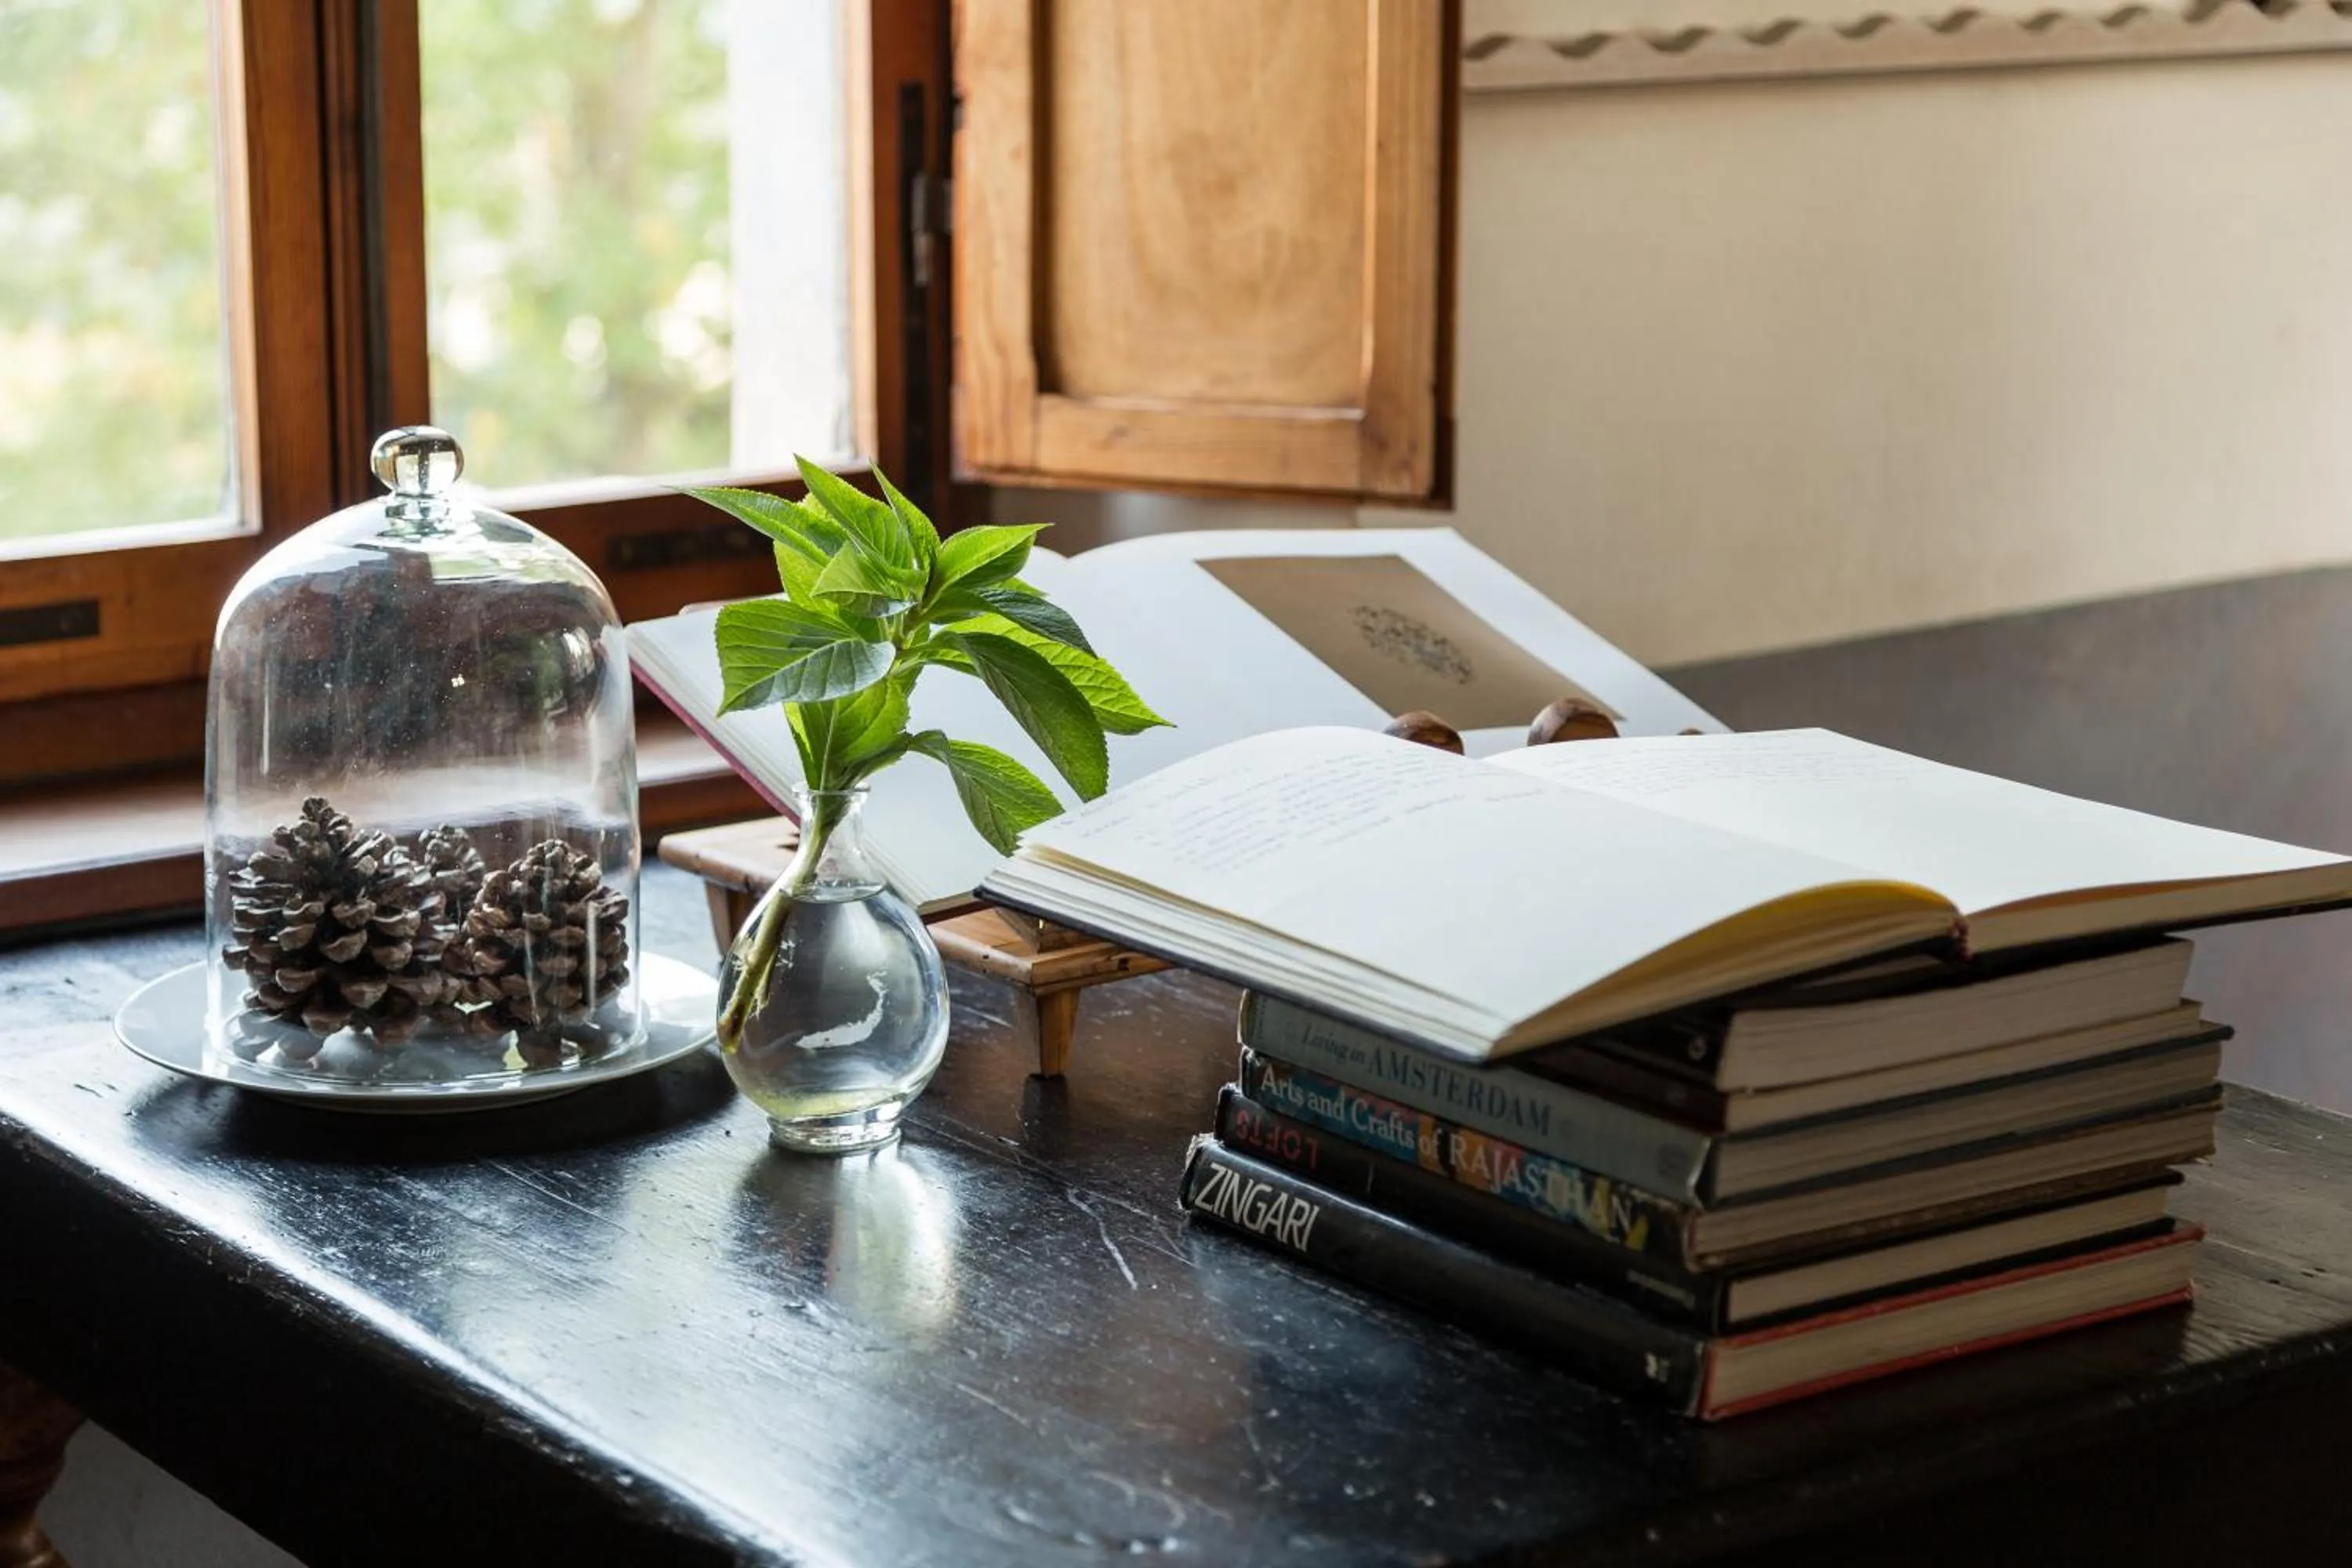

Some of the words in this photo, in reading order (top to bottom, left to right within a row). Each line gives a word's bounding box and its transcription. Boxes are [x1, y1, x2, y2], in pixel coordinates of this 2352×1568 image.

[1368, 1047, 1551, 1136] AMSTERDAM
[1236, 1109, 1319, 1169] LOFTS
[1261, 1062, 1304, 1108] Arts
[1307, 1088, 1345, 1123] and
[1351, 1098, 1414, 1149] Crafts
[1419, 1128, 1443, 1160] of
[1450, 1134, 1633, 1233] RAJASTHAN
[1195, 1161, 1320, 1253] ZINGARI
